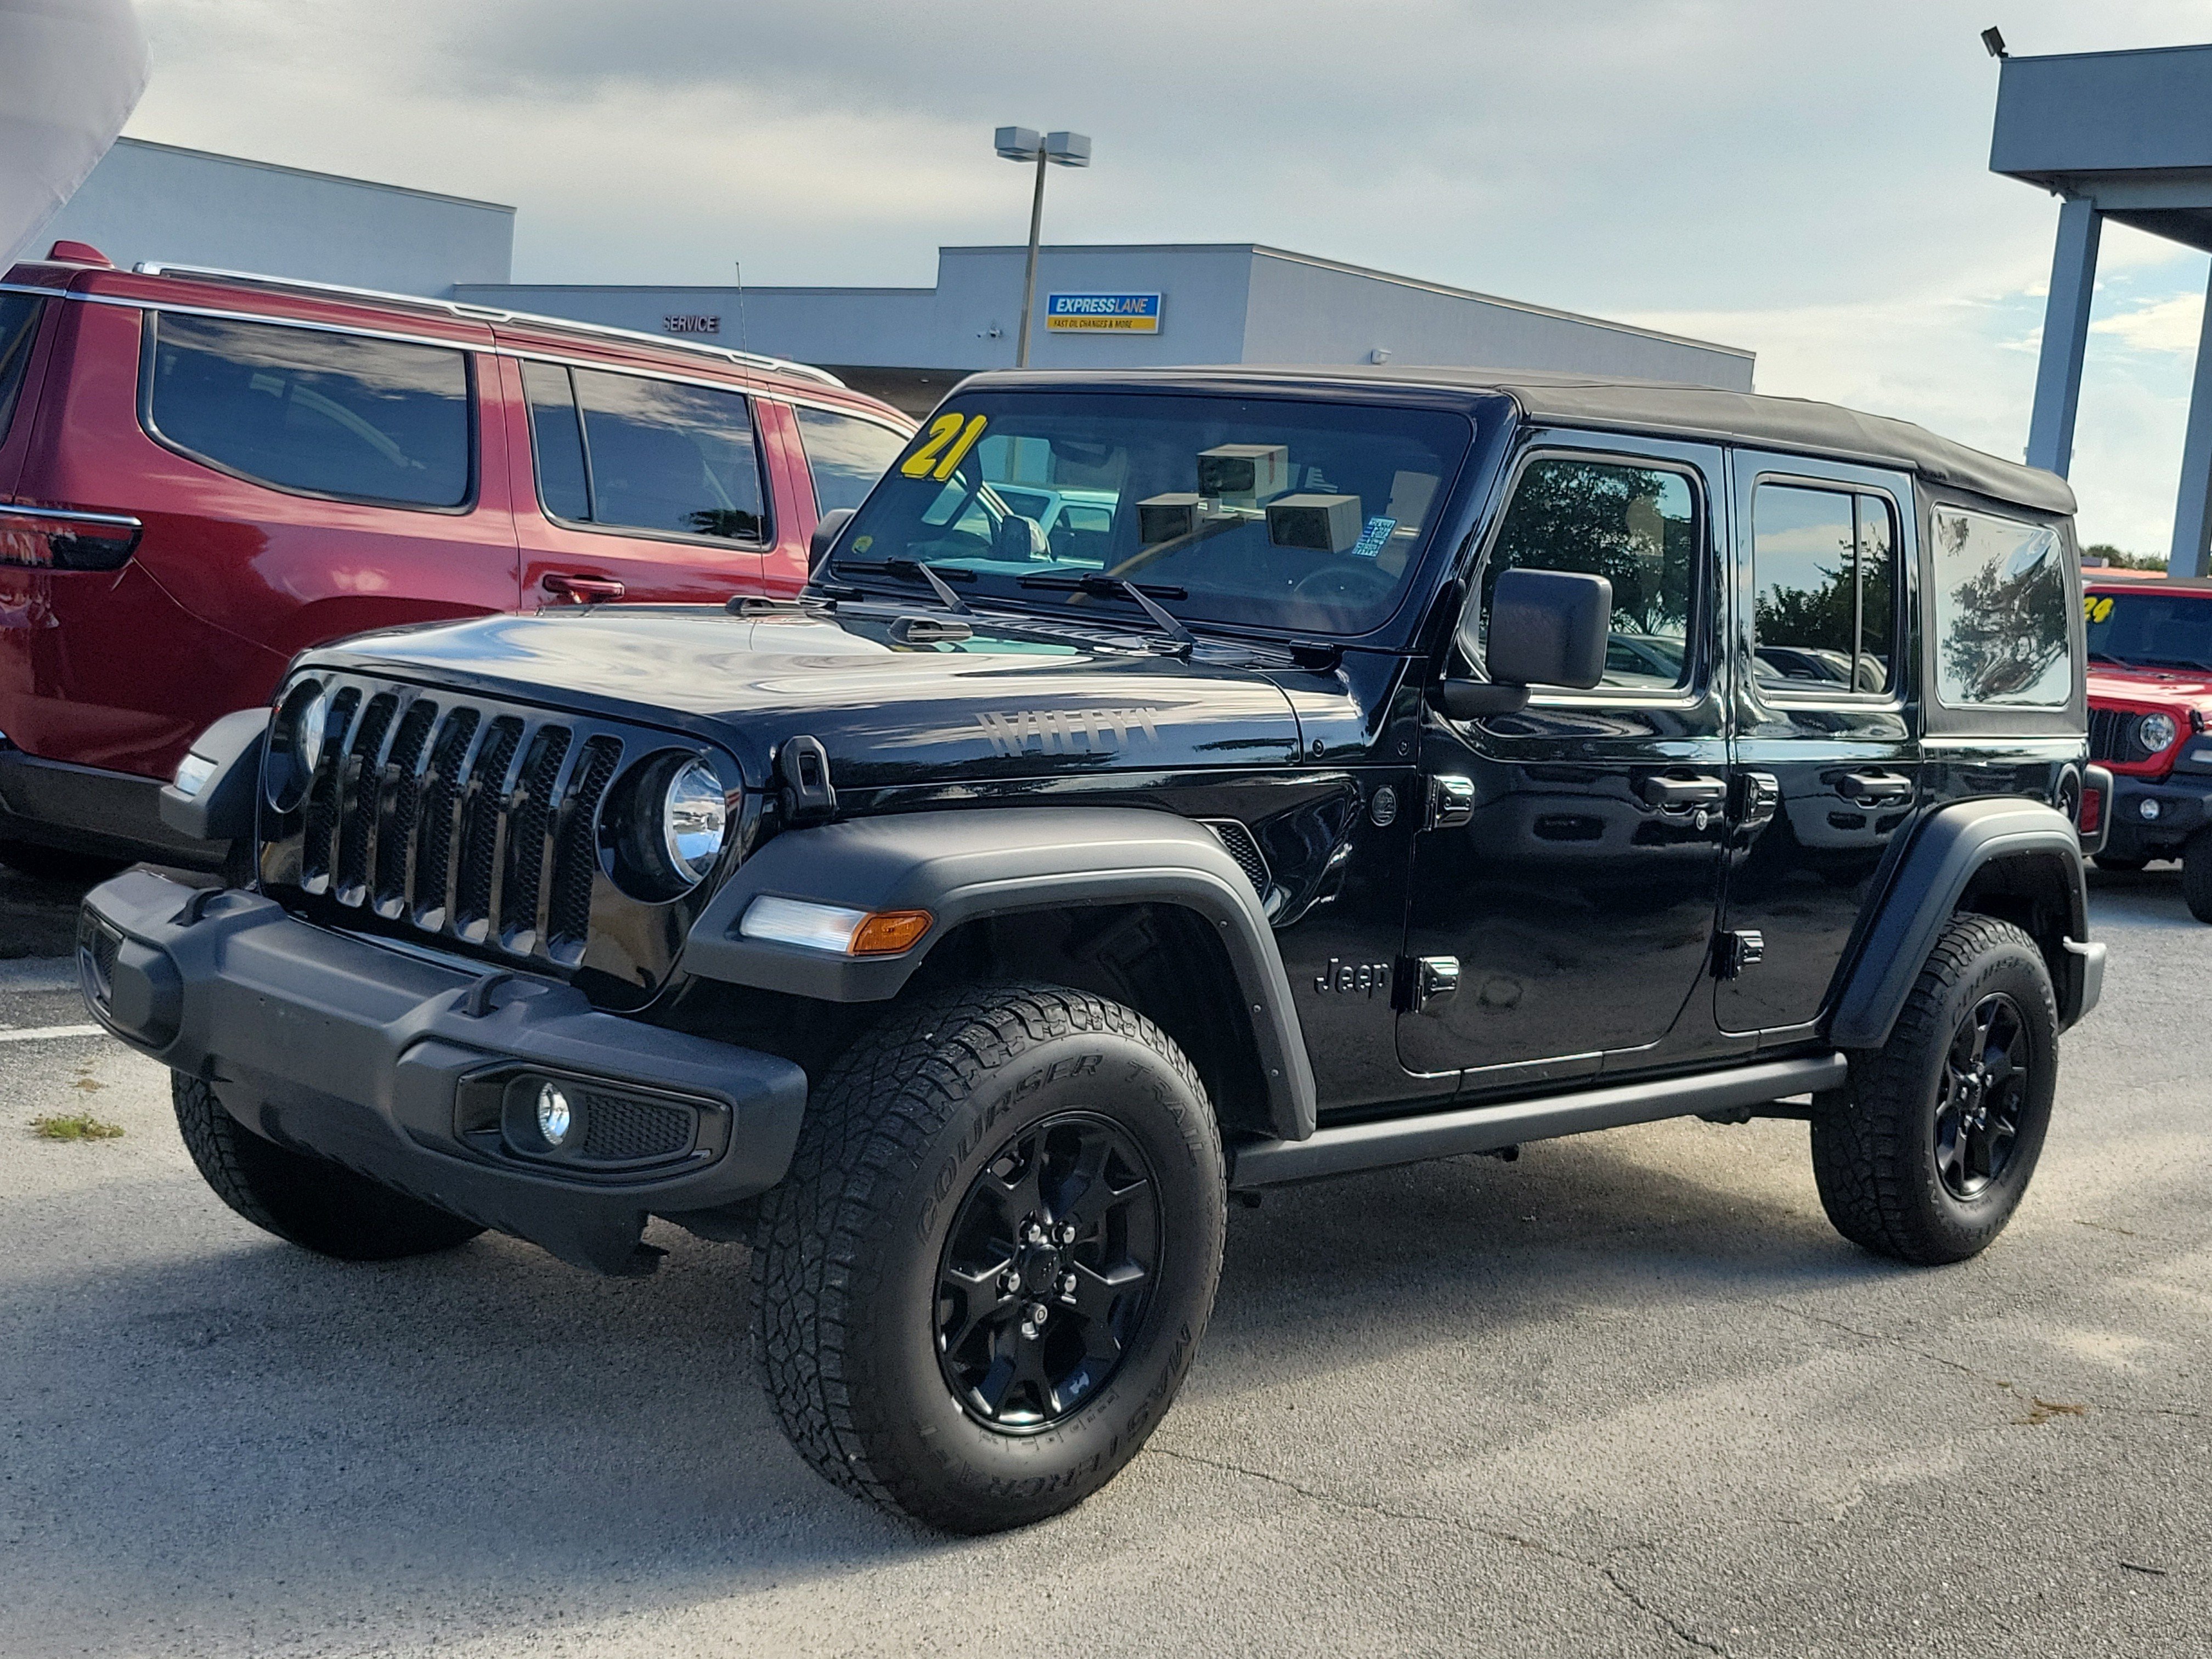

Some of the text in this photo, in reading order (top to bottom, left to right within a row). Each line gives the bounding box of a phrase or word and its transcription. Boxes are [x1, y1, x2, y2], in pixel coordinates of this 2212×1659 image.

[663, 315, 718, 332] SERVICE
[1054, 319, 1068, 328] FAST
[1069, 320, 1079, 328] OIL
[1079, 320, 1108, 328] CHANGES
[1114, 320, 1133, 329] MORE
[900, 413, 988, 482] 21
[2083, 597, 2114, 624] 24
[1314, 957, 1392, 1000] Jeep
[917, 1053, 1207, 1245] COURSER TRAIL
